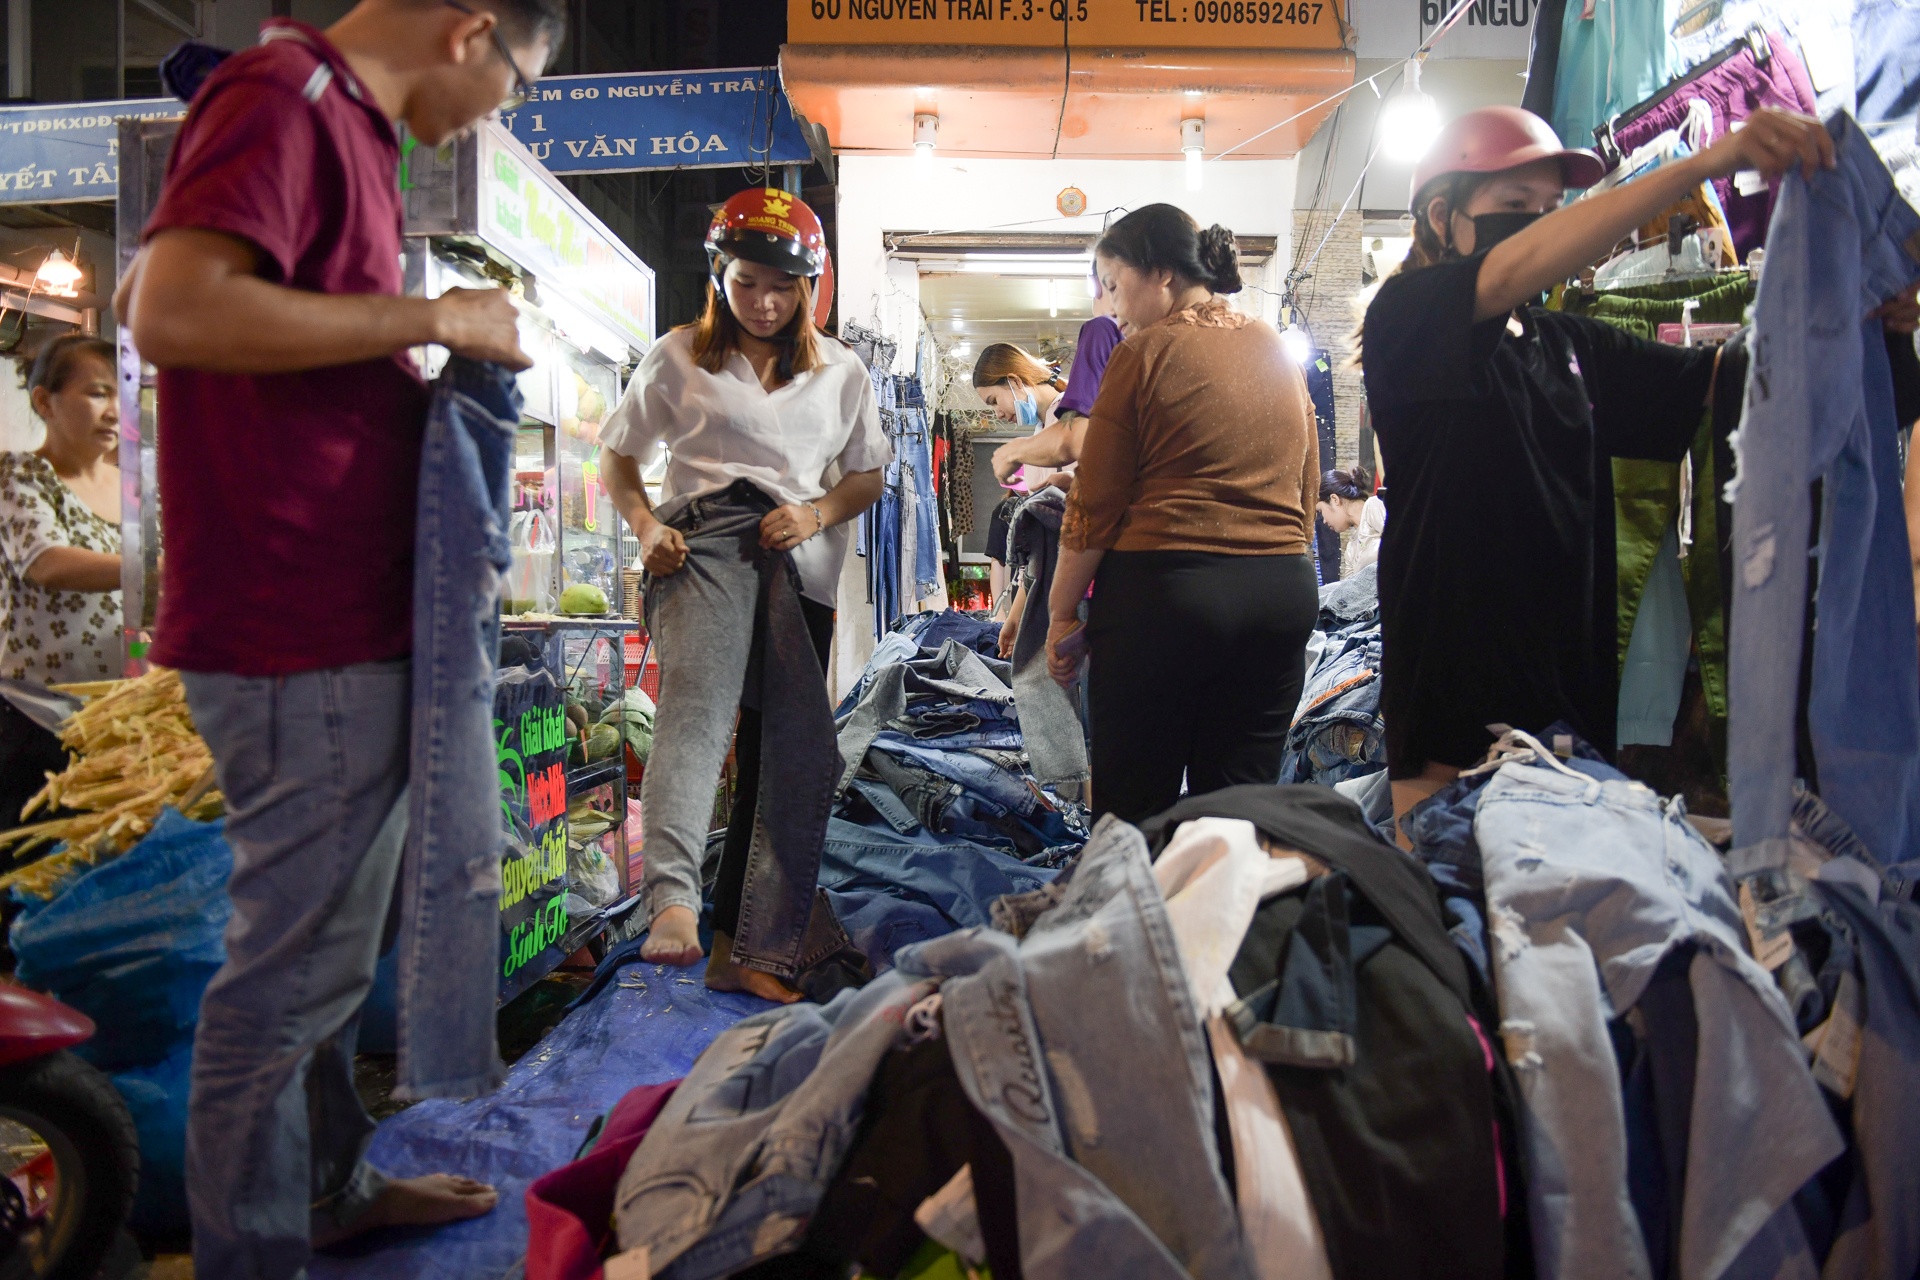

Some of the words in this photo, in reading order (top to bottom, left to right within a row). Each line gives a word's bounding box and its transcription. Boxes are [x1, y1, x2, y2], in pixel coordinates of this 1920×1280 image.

[812, 0, 841, 20] 60
[1194, 0, 1324, 25] 0908592467
[1467, 0, 1540, 27] NGU
[570, 87, 600, 100] 60
[607, 78, 702, 99] NGUYỄN
[531, 114, 547, 132] 1
[563, 134, 638, 158] VĂN
[649, 130, 729, 155] HÓA
[520, 705, 543, 758] Giải
[543, 702, 566, 752] khát
[503, 907, 547, 978] Sinh
